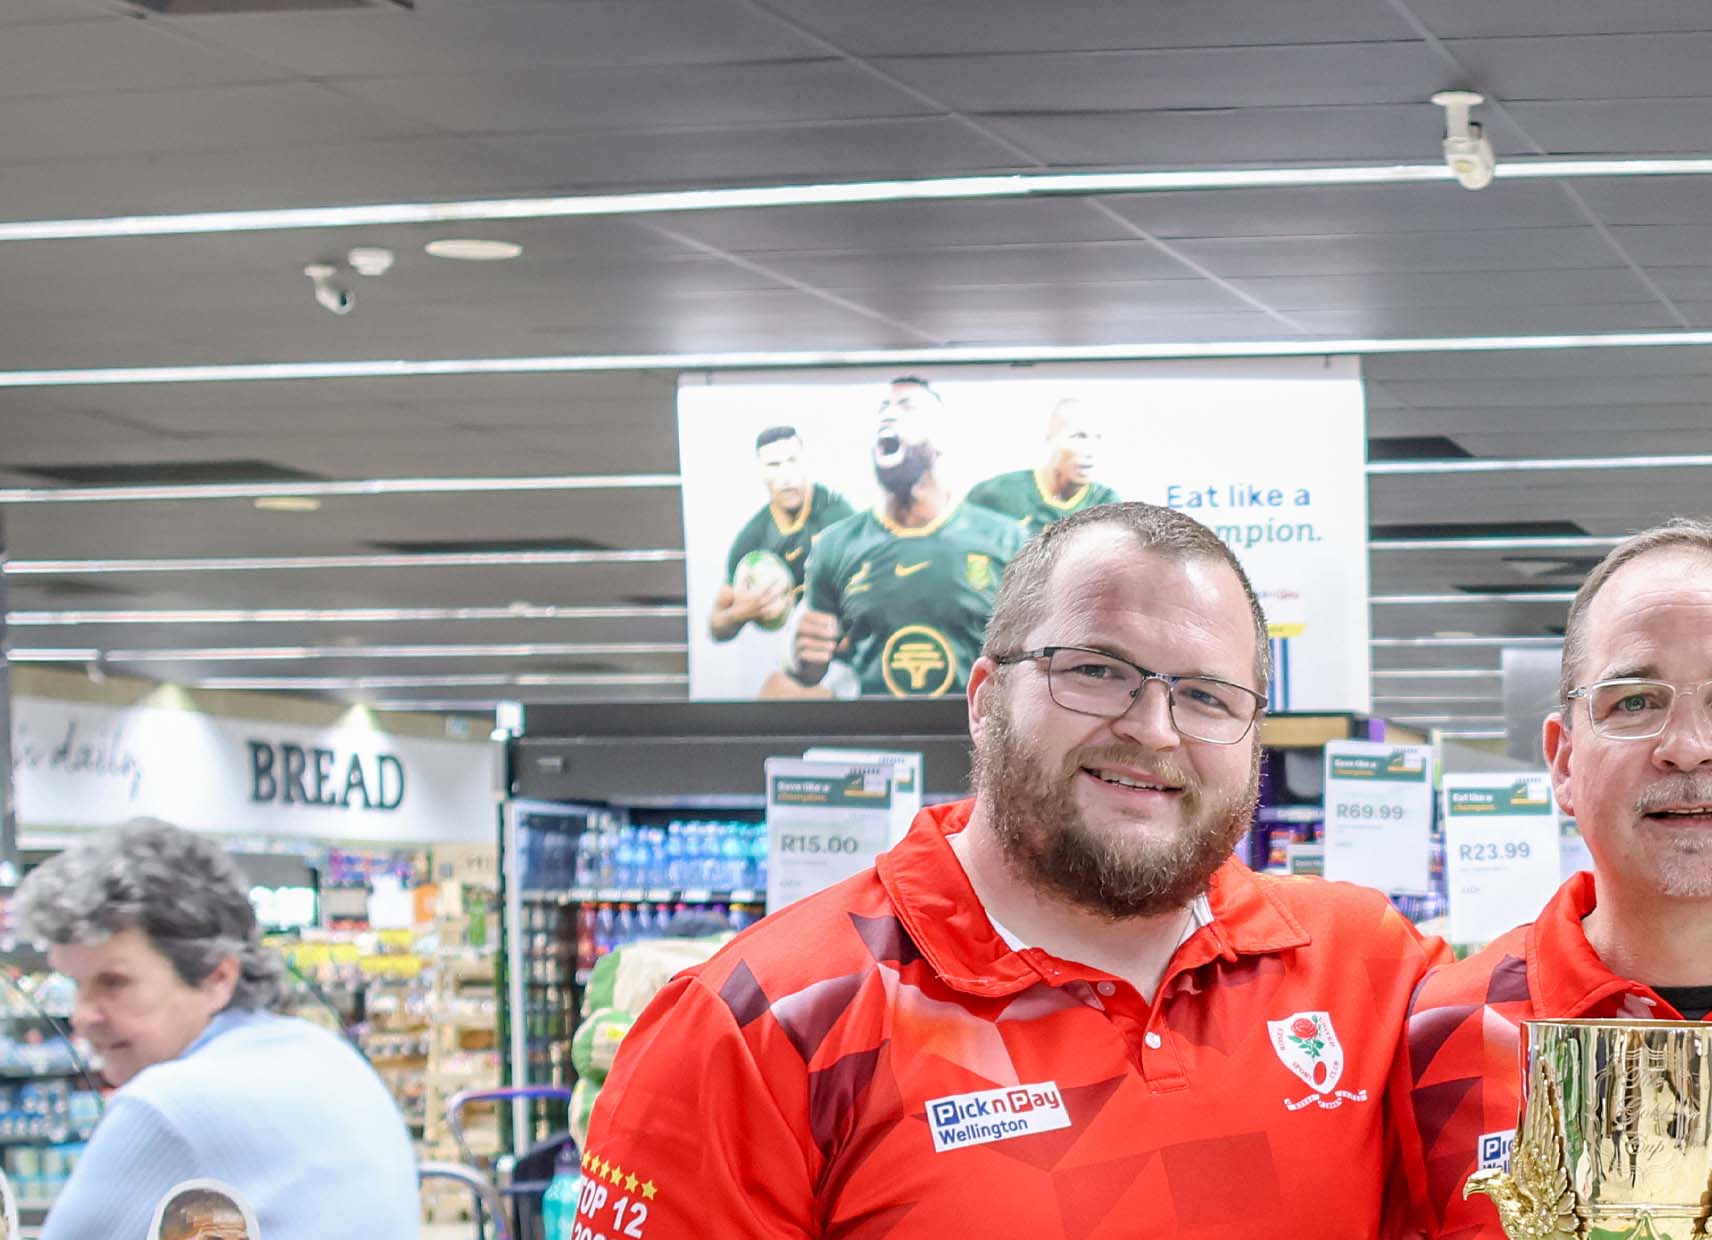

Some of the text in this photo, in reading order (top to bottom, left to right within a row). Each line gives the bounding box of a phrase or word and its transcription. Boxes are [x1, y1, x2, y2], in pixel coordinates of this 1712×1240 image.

[1167, 484, 1311, 508] Eat like a
[1215, 517, 1325, 549] mpion.
[247, 740, 405, 810] BREAD
[1336, 803, 1404, 820] R69.99
[779, 833, 859, 855] R15.00
[1458, 841, 1531, 861] R23.99
[932, 1089, 1060, 1128] Pick n Pay
[938, 1118, 1029, 1146] Wellington
[611, 1195, 649, 1240] 12
